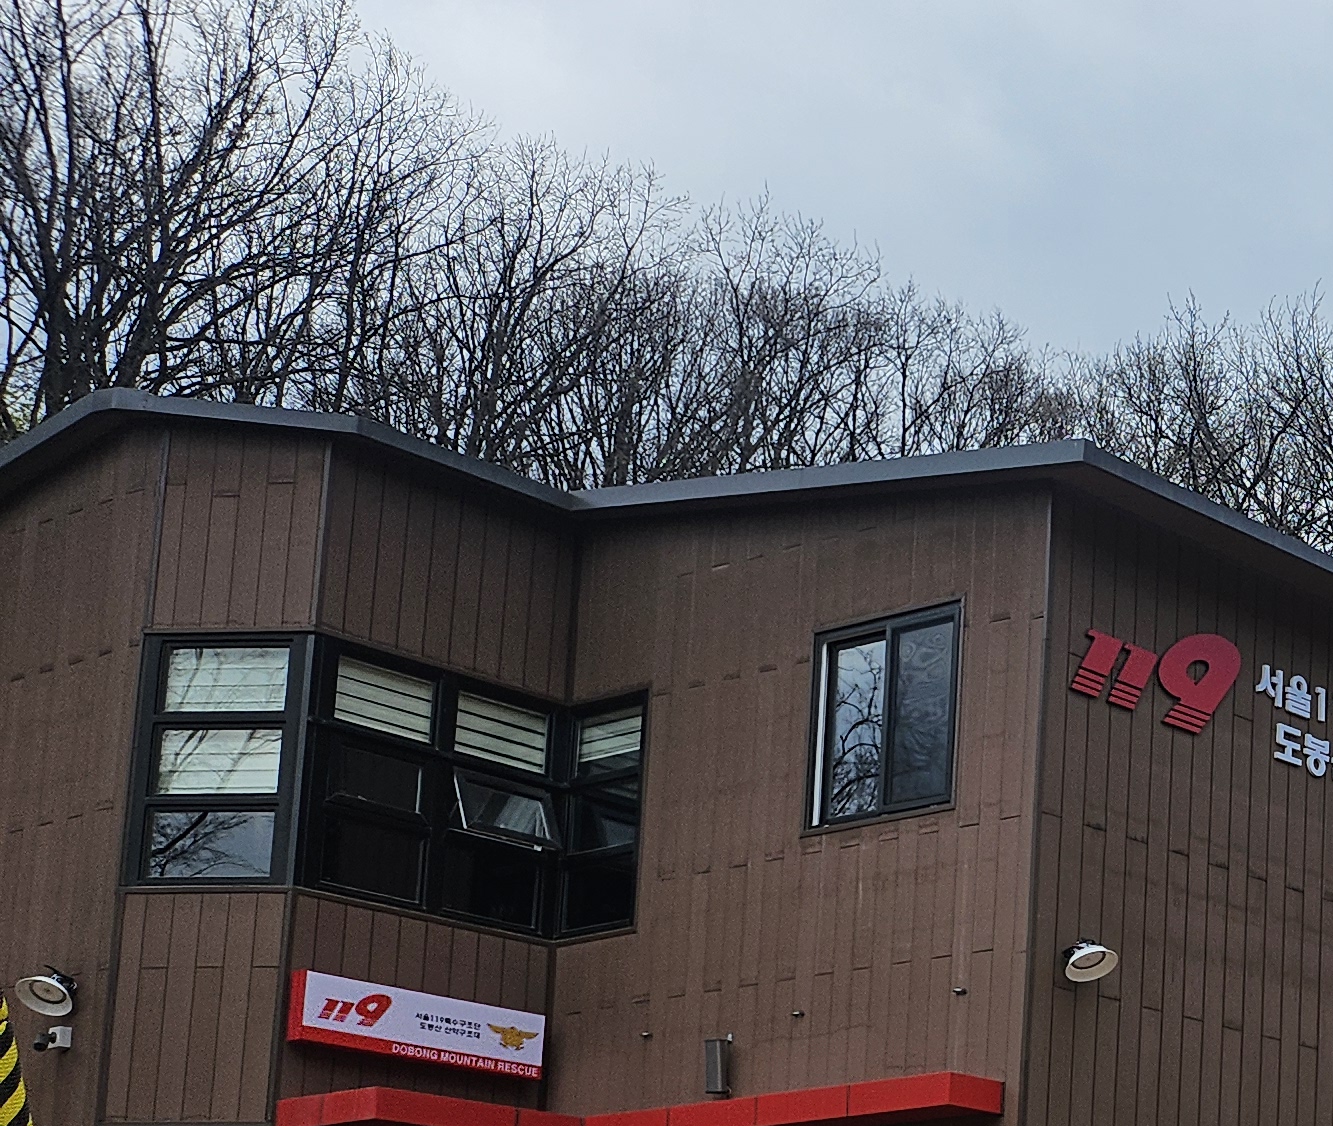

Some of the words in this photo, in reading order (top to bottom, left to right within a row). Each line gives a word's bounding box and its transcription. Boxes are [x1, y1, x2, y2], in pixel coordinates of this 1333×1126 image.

[1069, 629, 1242, 734] 119
[317, 994, 393, 1027] 119
[392, 1043, 438, 1060] DOBONG
[440, 1051, 495, 1070] MOUNTAIN
[497, 1061, 538, 1077] RESCUE
